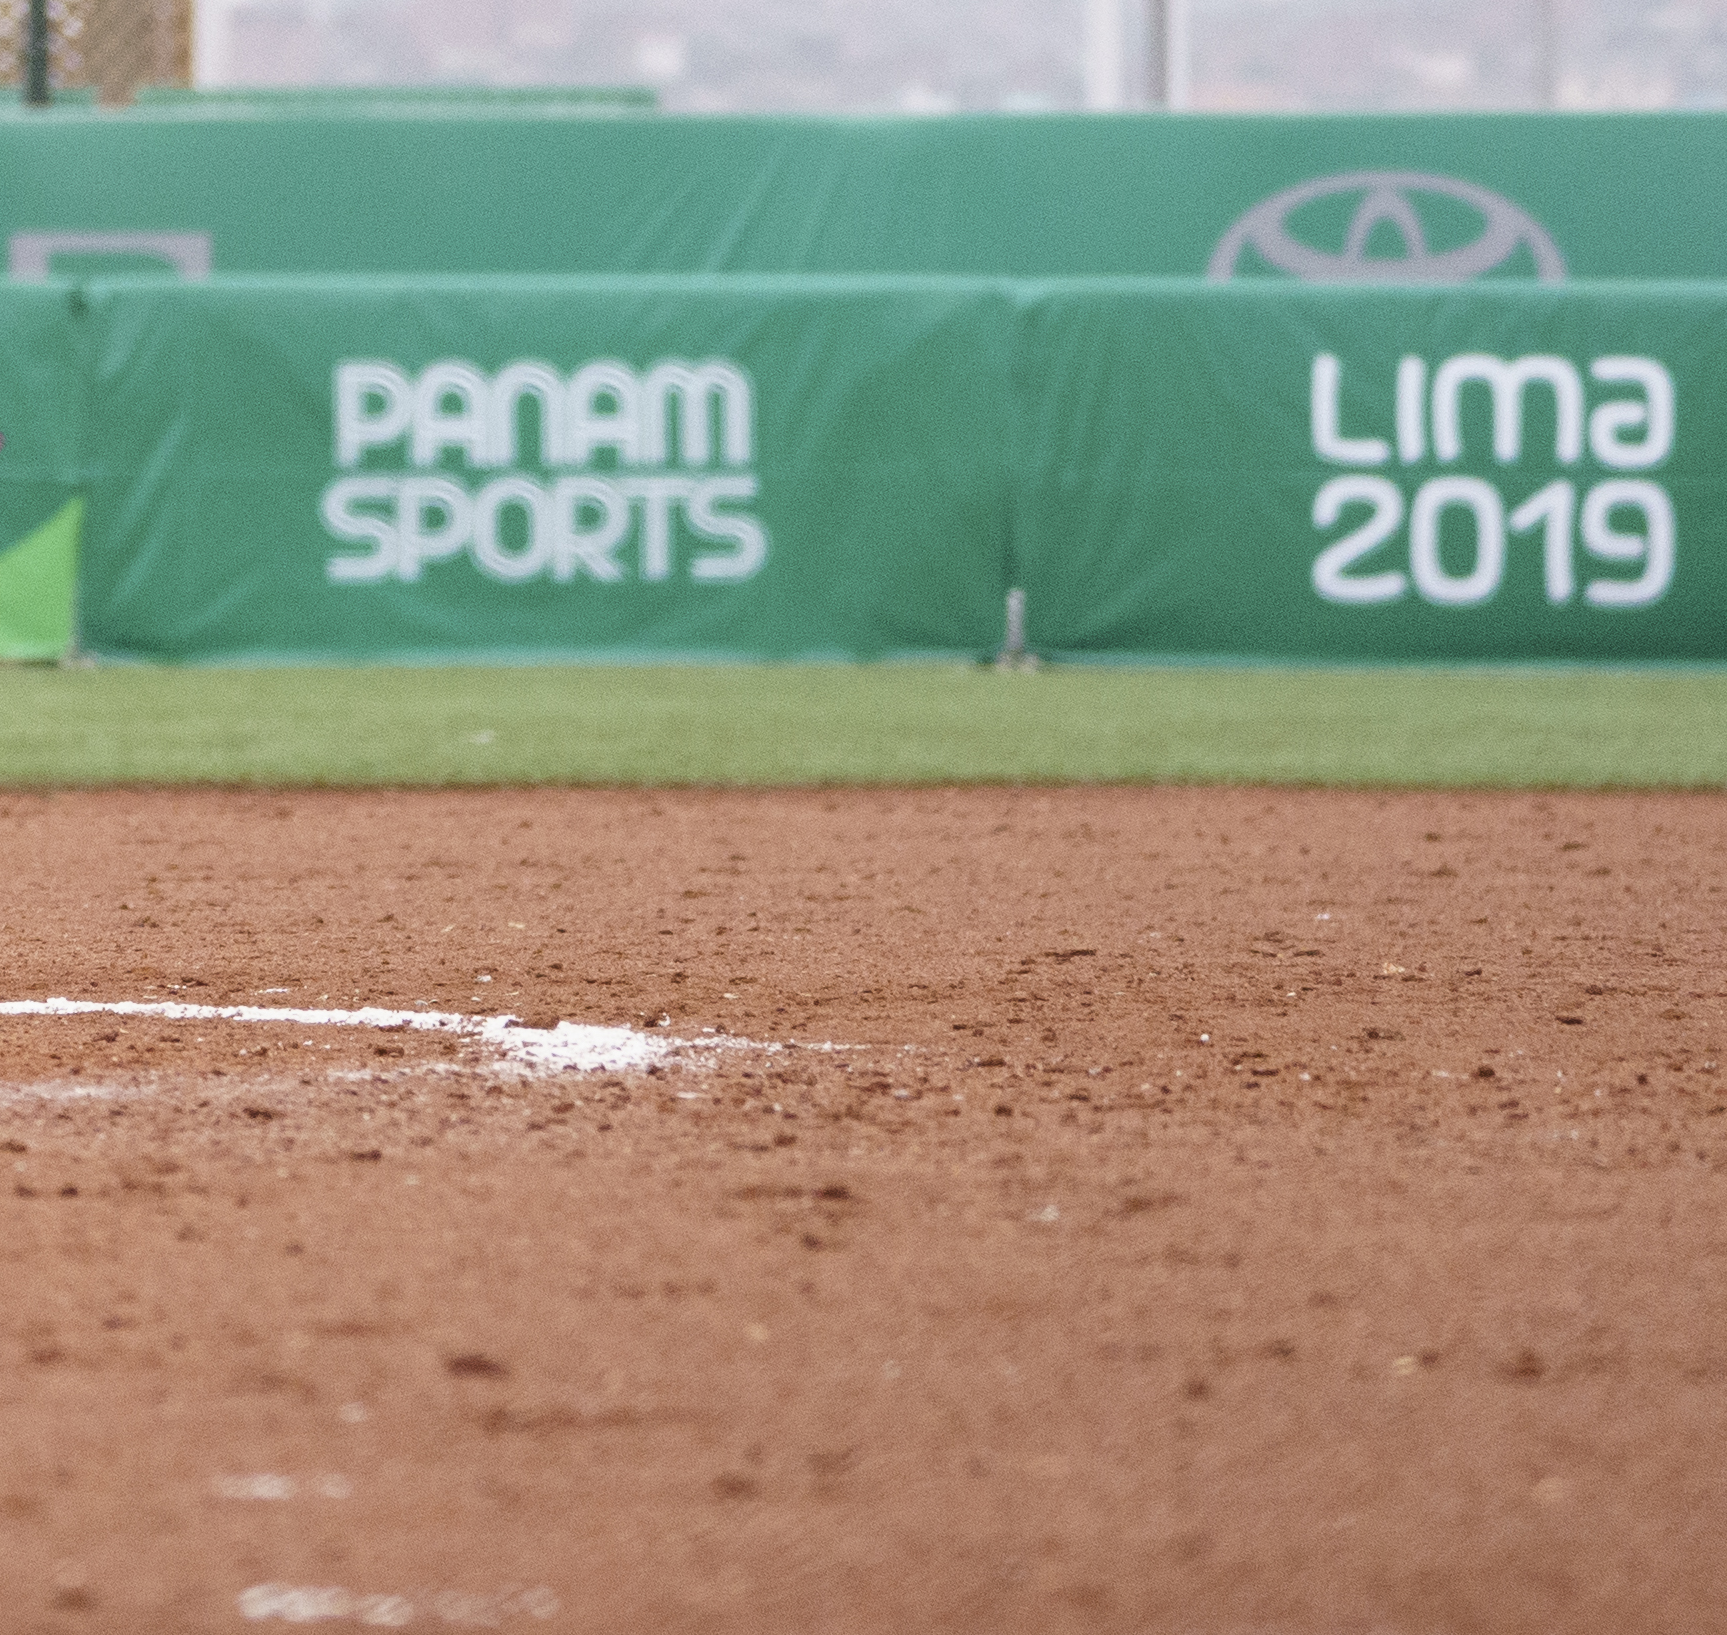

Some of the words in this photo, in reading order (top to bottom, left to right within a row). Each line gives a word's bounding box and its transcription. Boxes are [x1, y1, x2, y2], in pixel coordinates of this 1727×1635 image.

[333, 356, 754, 470] PANAM
[321, 473, 770, 585] SPORTS
[1310, 472, 1675, 608] 2019
